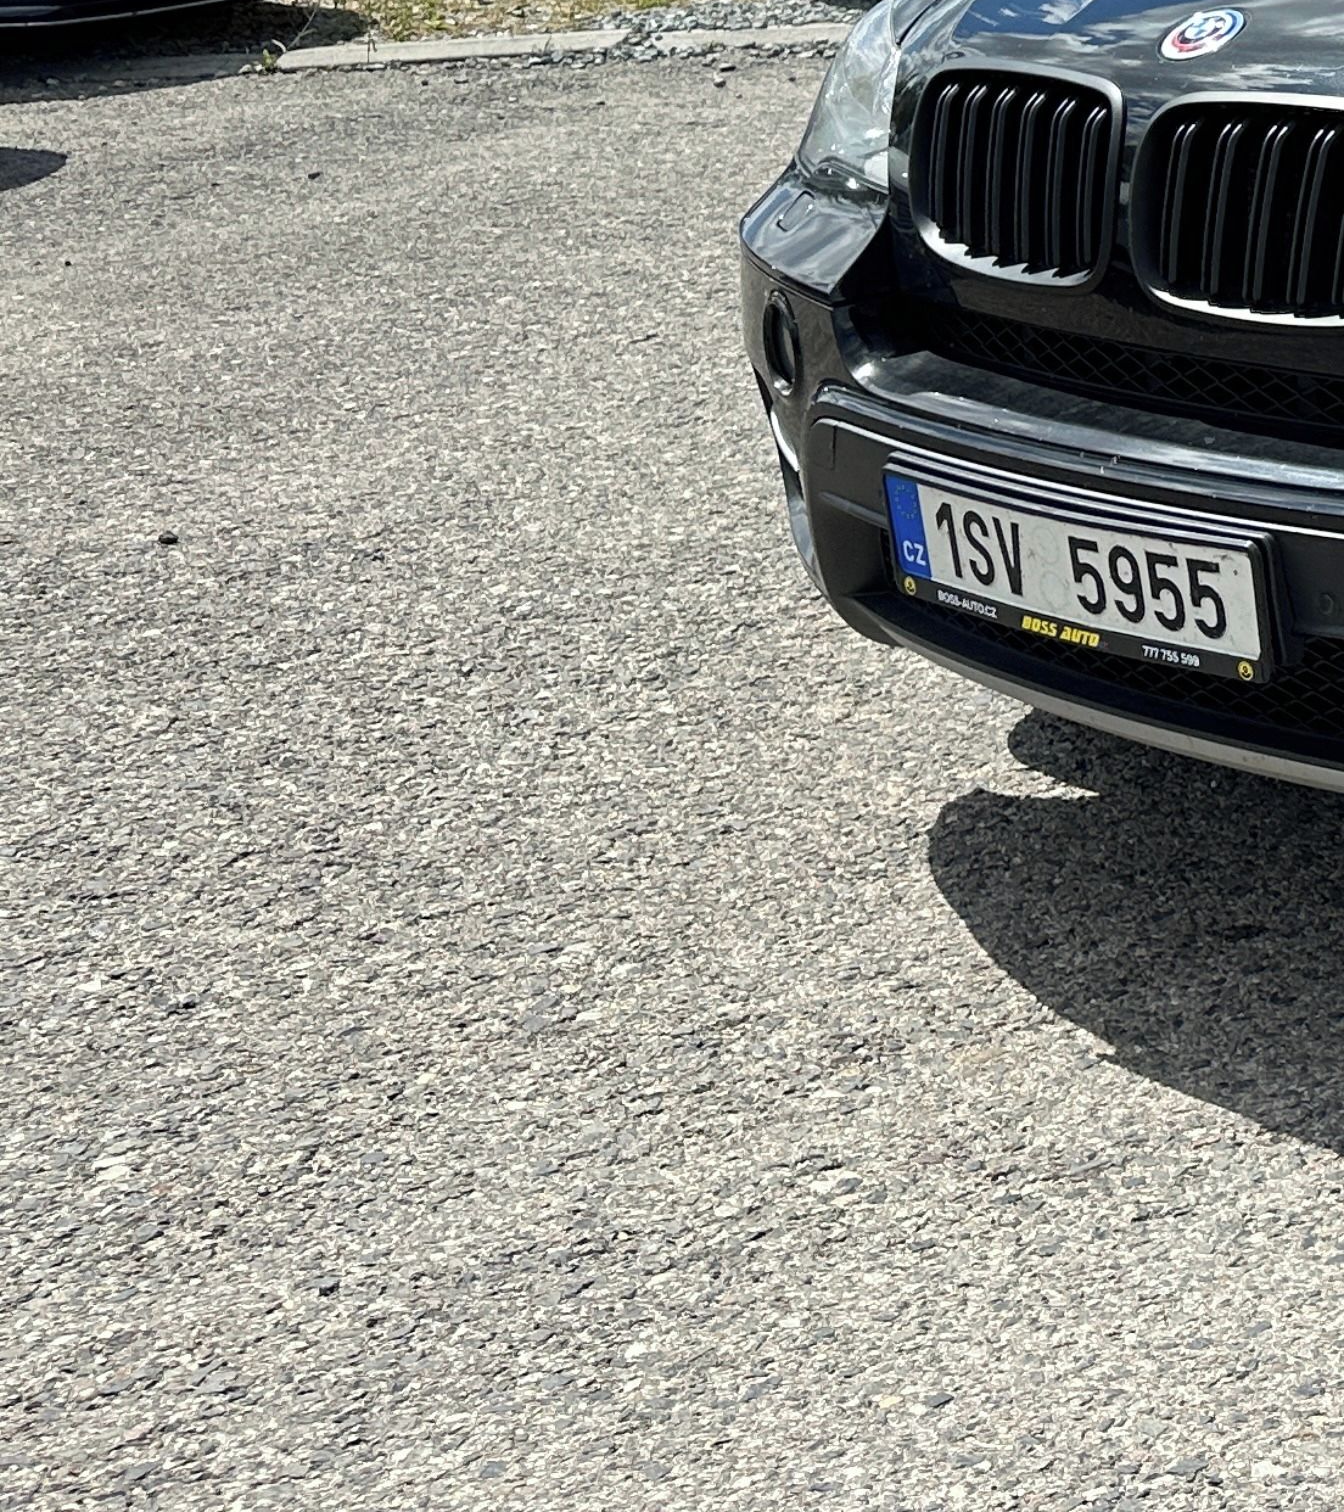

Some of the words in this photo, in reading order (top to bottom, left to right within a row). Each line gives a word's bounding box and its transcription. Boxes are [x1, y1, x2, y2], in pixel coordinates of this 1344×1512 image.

[903, 539, 927, 567] CZ
[935, 501, 1024, 597] 1SV
[1067, 535, 1227, 639] 5955
[937, 590, 999, 620] BOSS-AUTO.CZ
[1021, 615, 1058, 637] BOSS
[1060, 625, 1100, 648] AUTO
